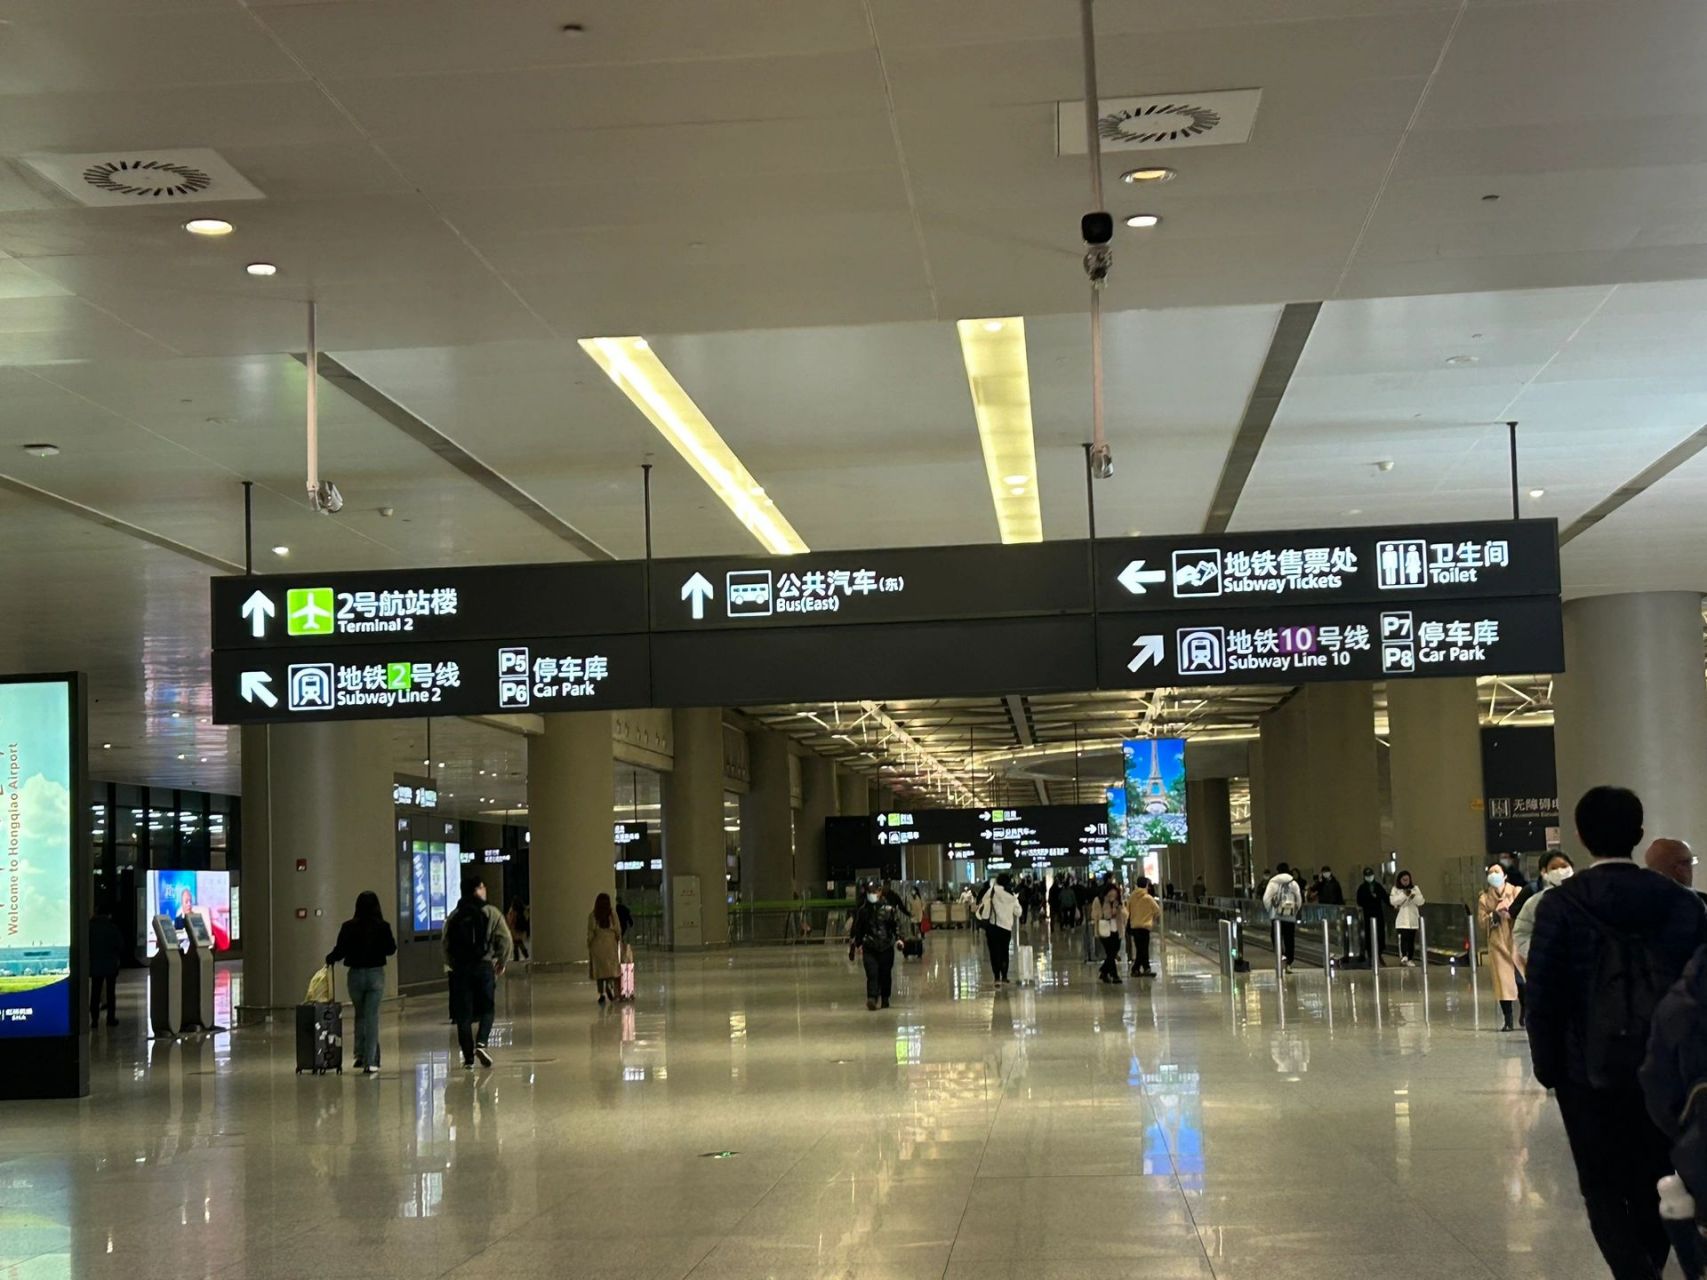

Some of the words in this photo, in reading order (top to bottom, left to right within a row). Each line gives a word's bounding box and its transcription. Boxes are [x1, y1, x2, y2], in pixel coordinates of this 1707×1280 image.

[1224, 546, 1358, 575] 地铁售票处
[1429, 540, 1509, 568] 卫生间
[1224, 575, 1287, 593] Subway
[1288, 573, 1342, 588] Tickets
[1429, 567, 1477, 583] Toilet
[337, 588, 458, 619] 2号航站楼
[777, 596, 839, 613] Bus(East)
[338, 619, 401, 633] Terminal
[404, 618, 413, 630] 2
[1384, 617, 1411, 636] P7
[1418, 619, 1499, 648] 停车库
[1227, 624, 1370, 654] 地铁10号线
[502, 652, 526, 672] P5
[1228, 653, 1291, 670] Subway
[1294, 652, 1327, 667] Line
[1332, 651, 1350, 666] 10
[1385, 647, 1413, 667] P8
[1419, 647, 1446, 662] Car
[1450, 646, 1485, 661] Park
[338, 662, 460, 690] 地铁2号线
[533, 655, 608, 683] 停车库
[338, 690, 396, 707] Subway
[398, 689, 429, 703] Line
[431, 688, 441, 701] 2
[503, 682, 527, 702] P6
[534, 683, 559, 698] Car
[562, 681, 595, 697] Park
[8, 743, 19, 789] Airport
[8, 793, 20, 855] Hongqiao
[8, 860, 18, 872] to
[8, 876, 18, 935] Welcome
